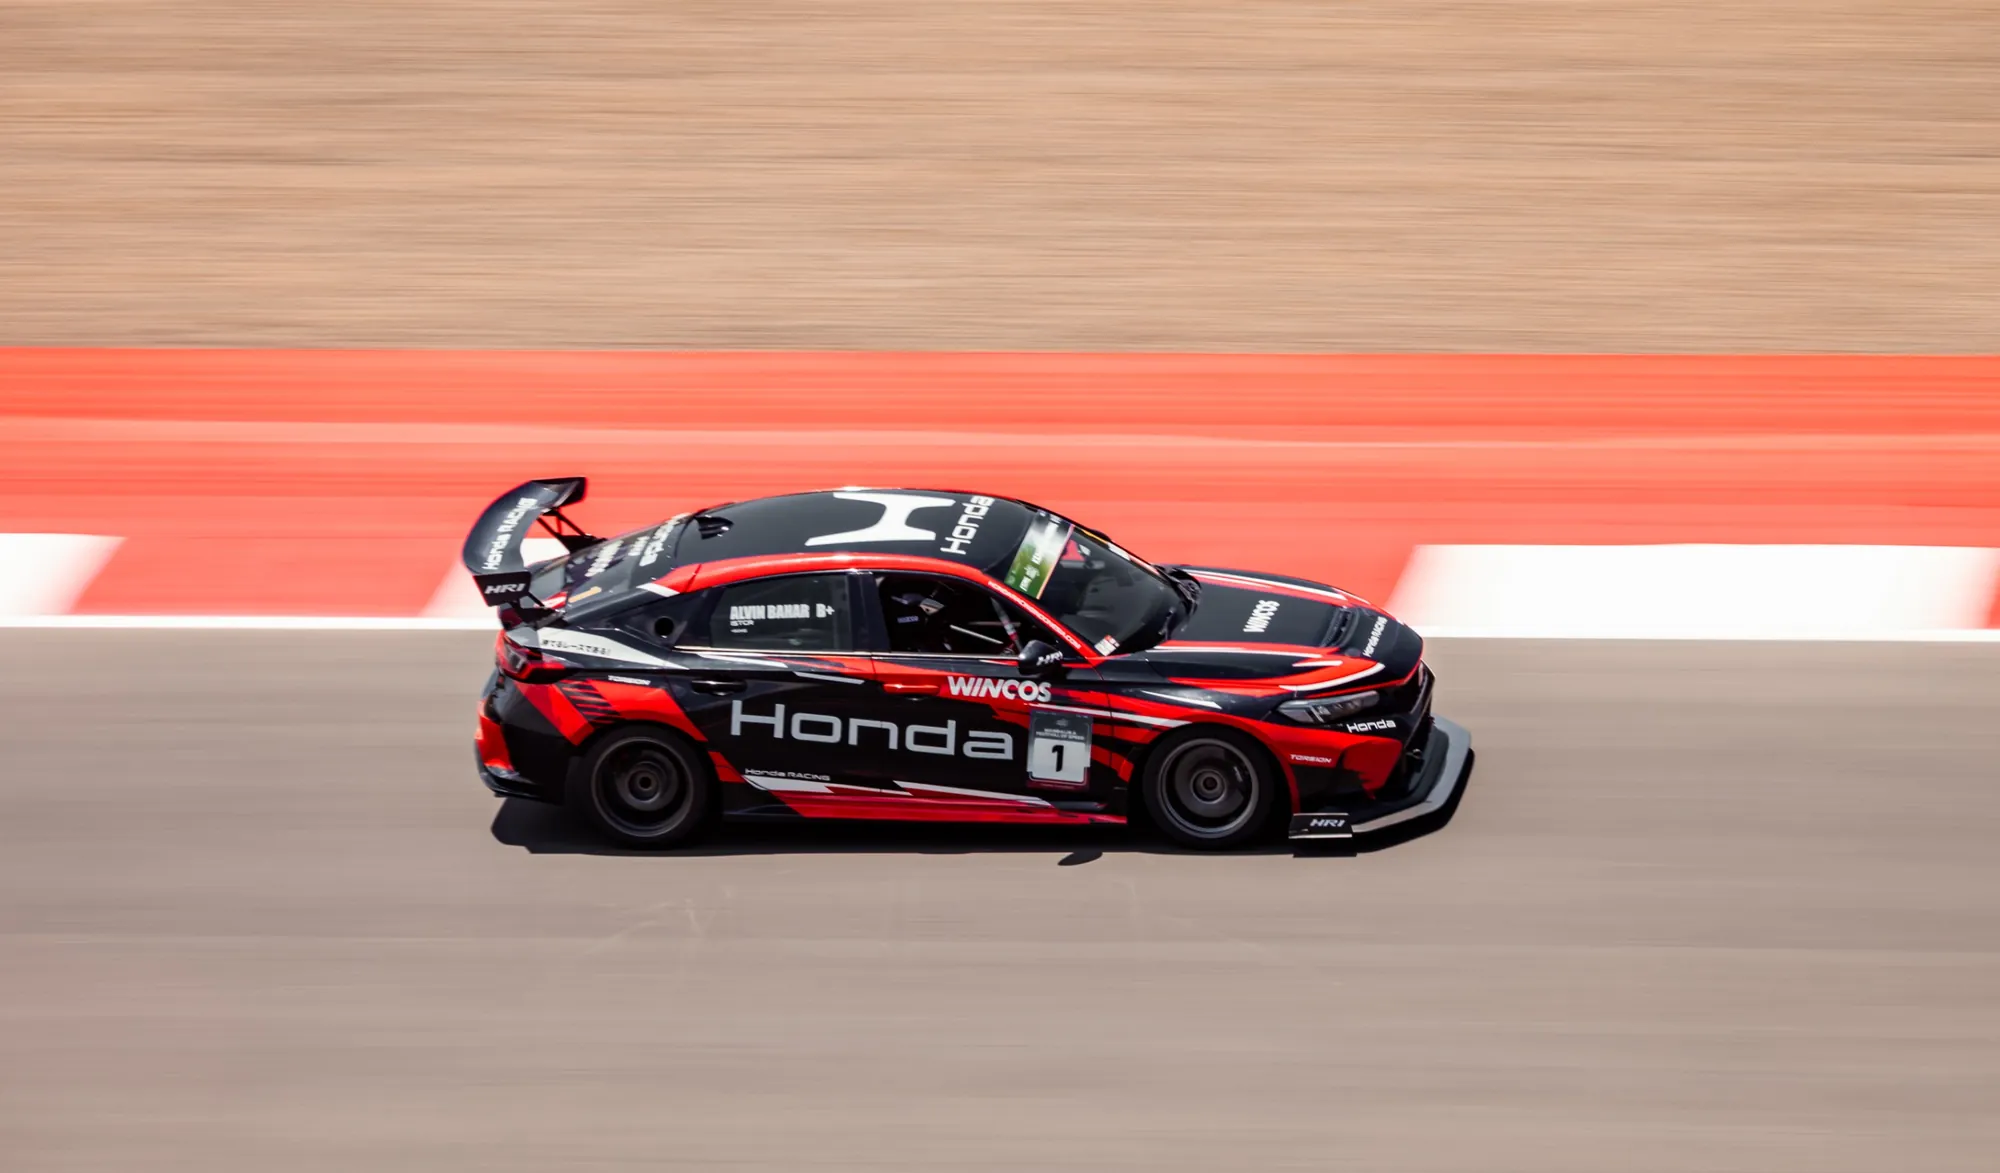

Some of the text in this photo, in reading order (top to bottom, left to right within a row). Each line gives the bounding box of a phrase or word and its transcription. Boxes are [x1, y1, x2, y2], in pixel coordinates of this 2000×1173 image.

[940, 495, 996, 555] Honda
[484, 583, 526, 595] HRI
[729, 605, 766, 620] ALVIN
[766, 603, 811, 619] BAHAR
[1242, 599, 1281, 633] WINCOS
[947, 675, 1052, 703] WINCOS
[730, 700, 1014, 760] Honda
[1346, 719, 1397, 733] Honda
[1052, 744, 1064, 772] 1
[1290, 754, 1332, 763] TORSION
[745, 768, 831, 781] Honda RACING
[1309, 819, 1346, 827] HRI
